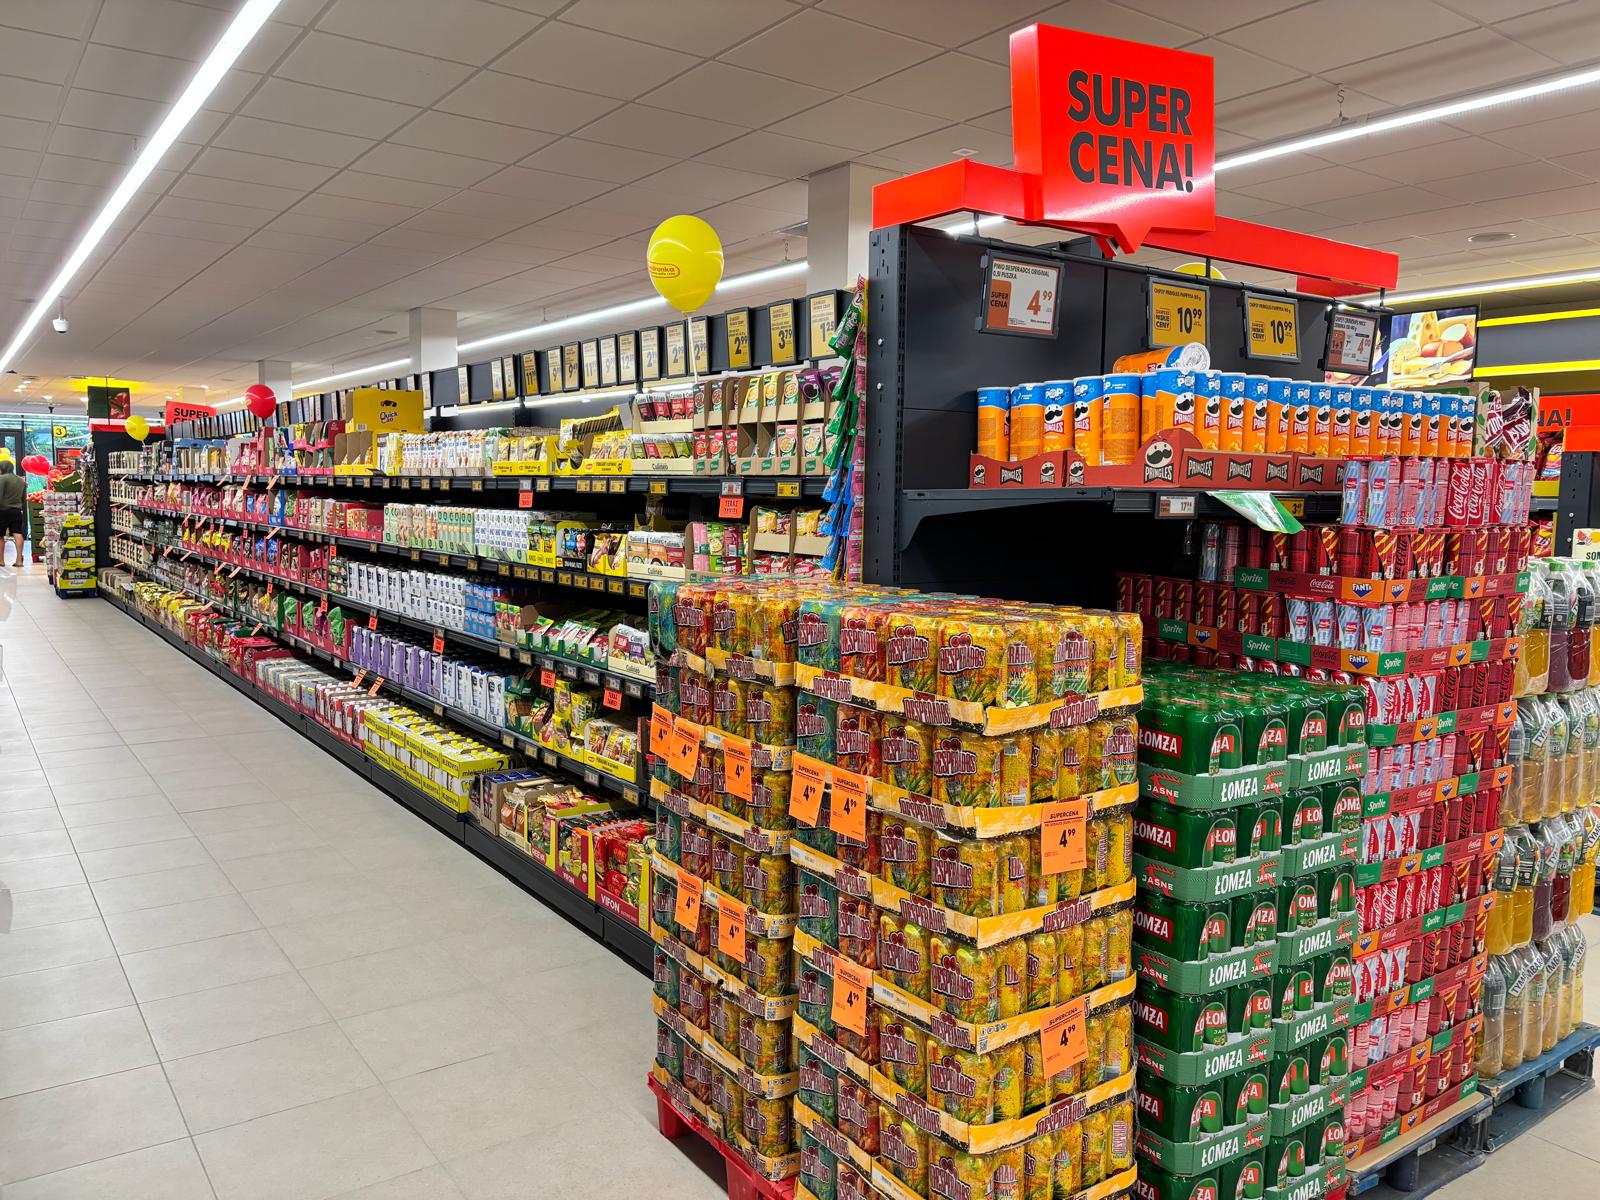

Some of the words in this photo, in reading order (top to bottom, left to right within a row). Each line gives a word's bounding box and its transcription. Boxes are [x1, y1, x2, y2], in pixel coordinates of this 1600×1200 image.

[1068, 70, 1192, 137] SUPER
[1069, 131, 1194, 193] CENA!
[1005, 265, 1031, 274] DESPERADOS
[1031, 268, 1049, 277] ORIGINAL
[990, 300, 1008, 308] CENA
[991, 292, 1008, 300] SUPER
[174, 408, 209, 418] SUPER
[380, 411, 398, 421] Quick
[56, 427, 63, 436] 3
[652, 462, 669, 471] Culineo
[1001, 467, 1024, 483] PRINGLES
[1145, 466, 1173, 483] PRINGLES
[1188, 460, 1213, 480] PRINGLES
[1229, 462, 1252, 478] PRINGLES
[1267, 464, 1288, 481] PRINGLES
[1301, 467, 1323, 482] PRINGLES
[1448, 464, 1471, 520] Coca-Cola
[1240, 572, 1263, 584] Sprite
[1309, 579, 1334, 590] Coca-Cola
[1352, 583, 1373, 592] FANTA
[1391, 583, 1405, 595] FANTA
[1429, 582, 1447, 592] Sprite
[1162, 623, 1184, 634] Sprite
[1196, 630, 1211, 639] FANTA
[1246, 640, 1270, 651] Sprite
[1349, 655, 1368, 665] FANTA
[1383, 659, 1401, 670] Sprite
[939, 643, 986, 675] DESPERADOS
[813, 676, 851, 700] DESPERADOS
[904, 695, 951, 726] DESPERADOS
[1051, 695, 1099, 730] DESPERADOS
[1437, 716, 1452, 729] Sprite
[1480, 709, 1496, 720] Coca-Cola
[1138, 728, 1179, 754] ŁOMŻA
[798, 765, 819, 776] SUPERCENA
[933, 750, 977, 778] DESPERADOS
[1308, 758, 1341, 781] ŁOMŻA
[1344, 762, 1362, 772] JASNE
[837, 777, 860, 789] SUPERCENA
[1147, 785, 1180, 798] JASNE
[1221, 777, 1258, 802] ŁOMŻA
[1262, 781, 1283, 792] JASNE
[899, 800, 948, 829] DESPERADOS
[1049, 810, 1079, 820] SUPERCENA
[1367, 800, 1386, 811] Sprite
[1133, 819, 1173, 848] ŁOMŻA
[1302, 844, 1336, 870] ŁOMŻA
[1339, 846, 1358, 857] JASNE
[1426, 852, 1442, 862] Sprite
[1142, 874, 1174, 891] JASNE
[1214, 869, 1252, 896] ŁOMŻA
[1256, 872, 1277, 882] JASNE
[600, 893, 620, 914] VIFON
[900, 902, 948, 934] DESPERADOS
[1043, 902, 1092, 933] DESPERADOS
[1381, 929, 1397, 940] Coca-Cola
[1425, 915, 1440, 927] Sprite
[1298, 930, 1332, 957] ŁOMŻA
[1335, 930, 1353, 941] JASNE
[839, 968, 861, 984] SUPERCENA
[931, 966, 975, 1000] DESPERADOS
[1136, 965, 1168, 982] JASNE
[1208, 959, 1247, 987] ŁOMŻA
[1251, 962, 1272, 973] JASNE
[1415, 984, 1430, 996] Sprite
[1049, 1007, 1078, 1025] SUPERCENA
[931, 1015, 972, 1050] DESPERADOS
[1295, 1019, 1328, 1043] ŁOMŻA
[1331, 1013, 1349, 1024] JASNE
[1139, 1058, 1165, 1072] ASNE
[1204, 1049, 1243, 1077] ŁOMŻA
[1247, 1049, 1268, 1062] JASNE
[930, 1065, 976, 1098] DESPERADOS
[896, 1094, 941, 1136] DESPERADOS
[1037, 1099, 1087, 1135] DESPERADOS
[1291, 1097, 1324, 1127] ŁOMŻA
[1327, 1094, 1345, 1106] JASNE
[1137, 1142, 1162, 1160] ASNE
[1201, 1136, 1239, 1167] ŁOMŻA
[1243, 1134, 1264, 1148] JASNE
[1324, 1173, 1341, 1186] JASNE
